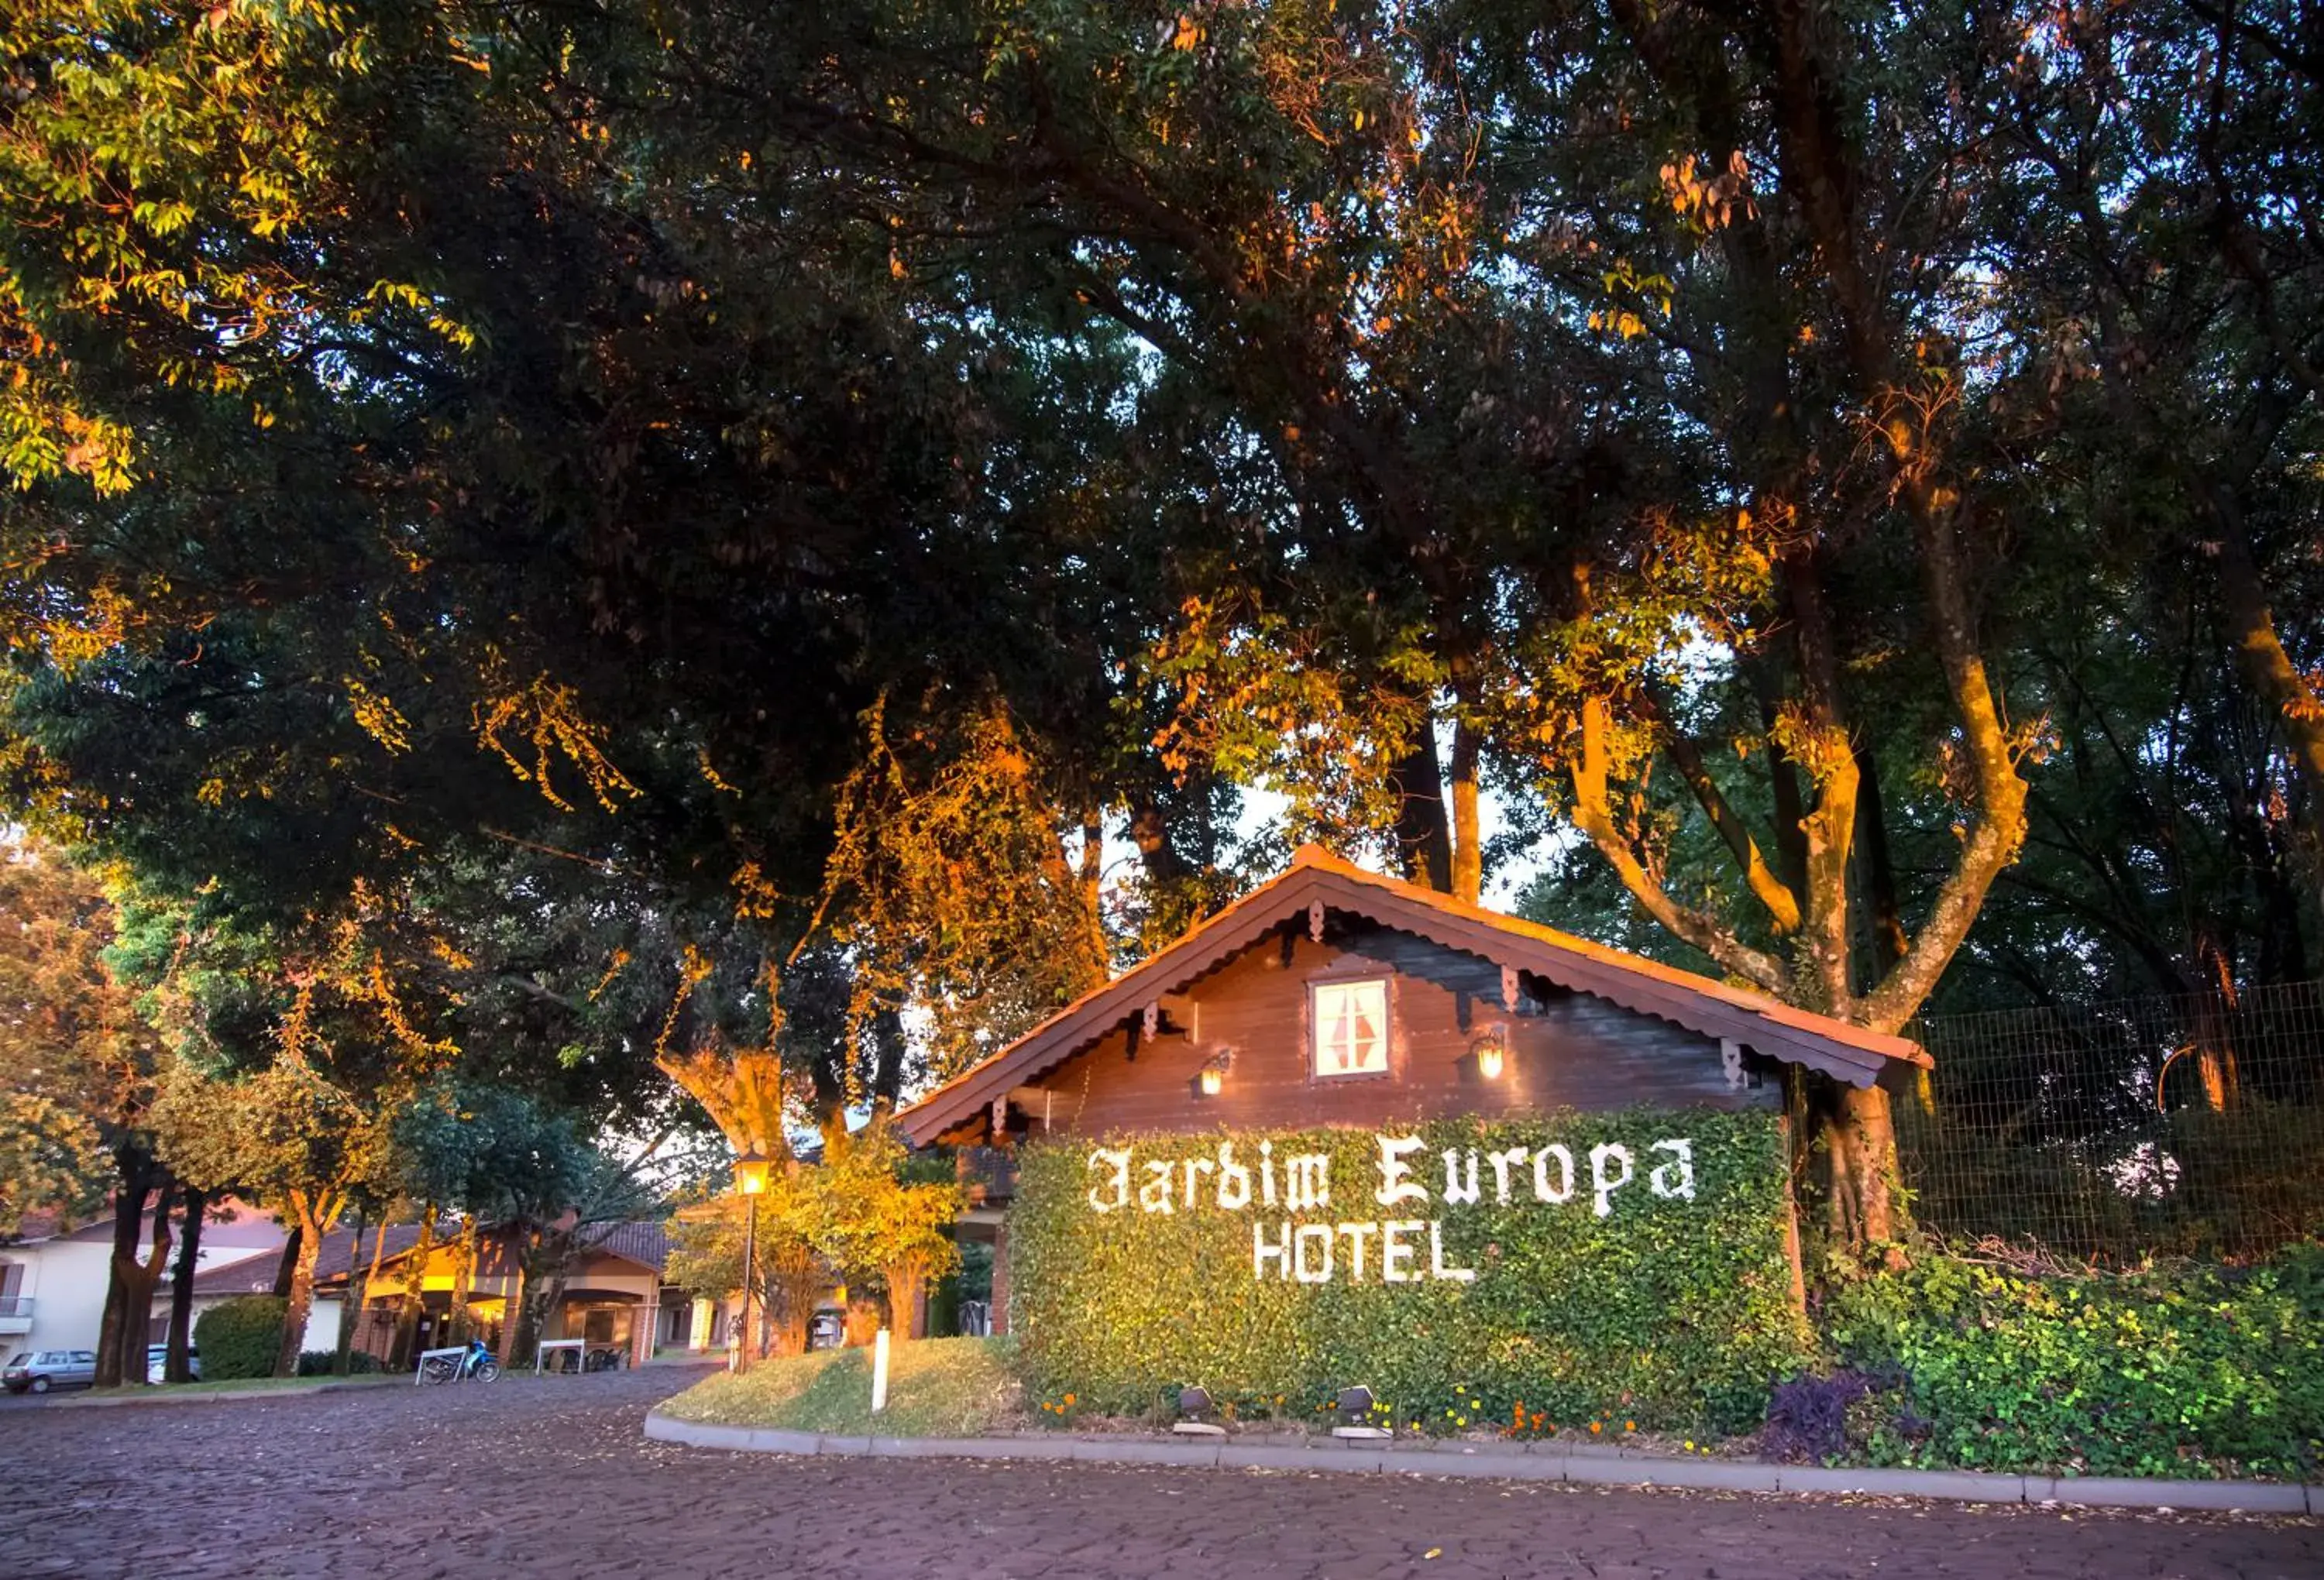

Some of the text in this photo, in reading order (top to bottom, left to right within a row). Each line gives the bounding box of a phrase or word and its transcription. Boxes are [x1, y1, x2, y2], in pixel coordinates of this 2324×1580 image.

[1088, 1133, 1697, 1218] Jardim Europa
[1253, 1219, 1475, 1283] HOTEL
